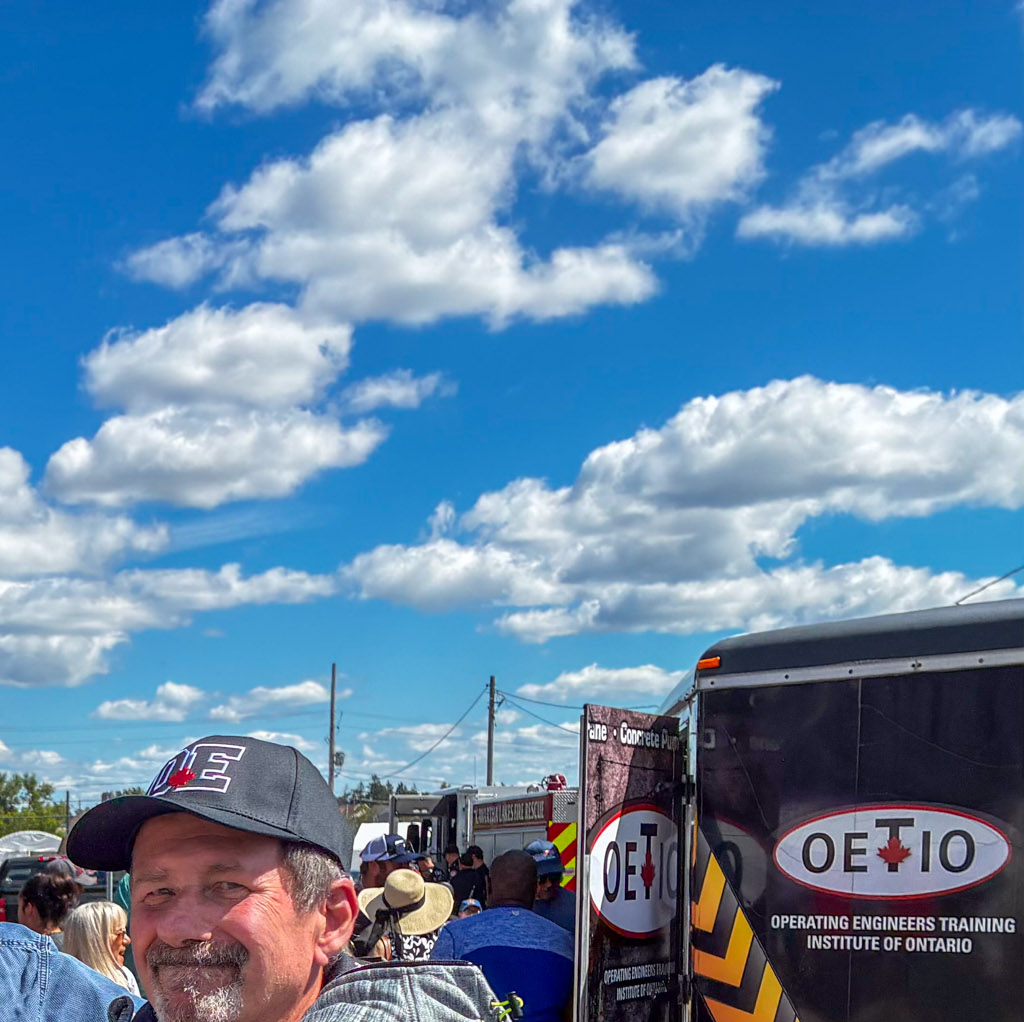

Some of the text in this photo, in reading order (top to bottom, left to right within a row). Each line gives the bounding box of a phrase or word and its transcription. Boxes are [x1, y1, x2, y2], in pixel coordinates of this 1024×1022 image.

[620, 721, 660, 749] Concrete
[801, 817, 975, 873] OETIO
[771, 914, 1016, 933] OPERATING ENGINEERS TRAINING
[807, 935, 972, 953] INSTITUTE OF ONTARIO
